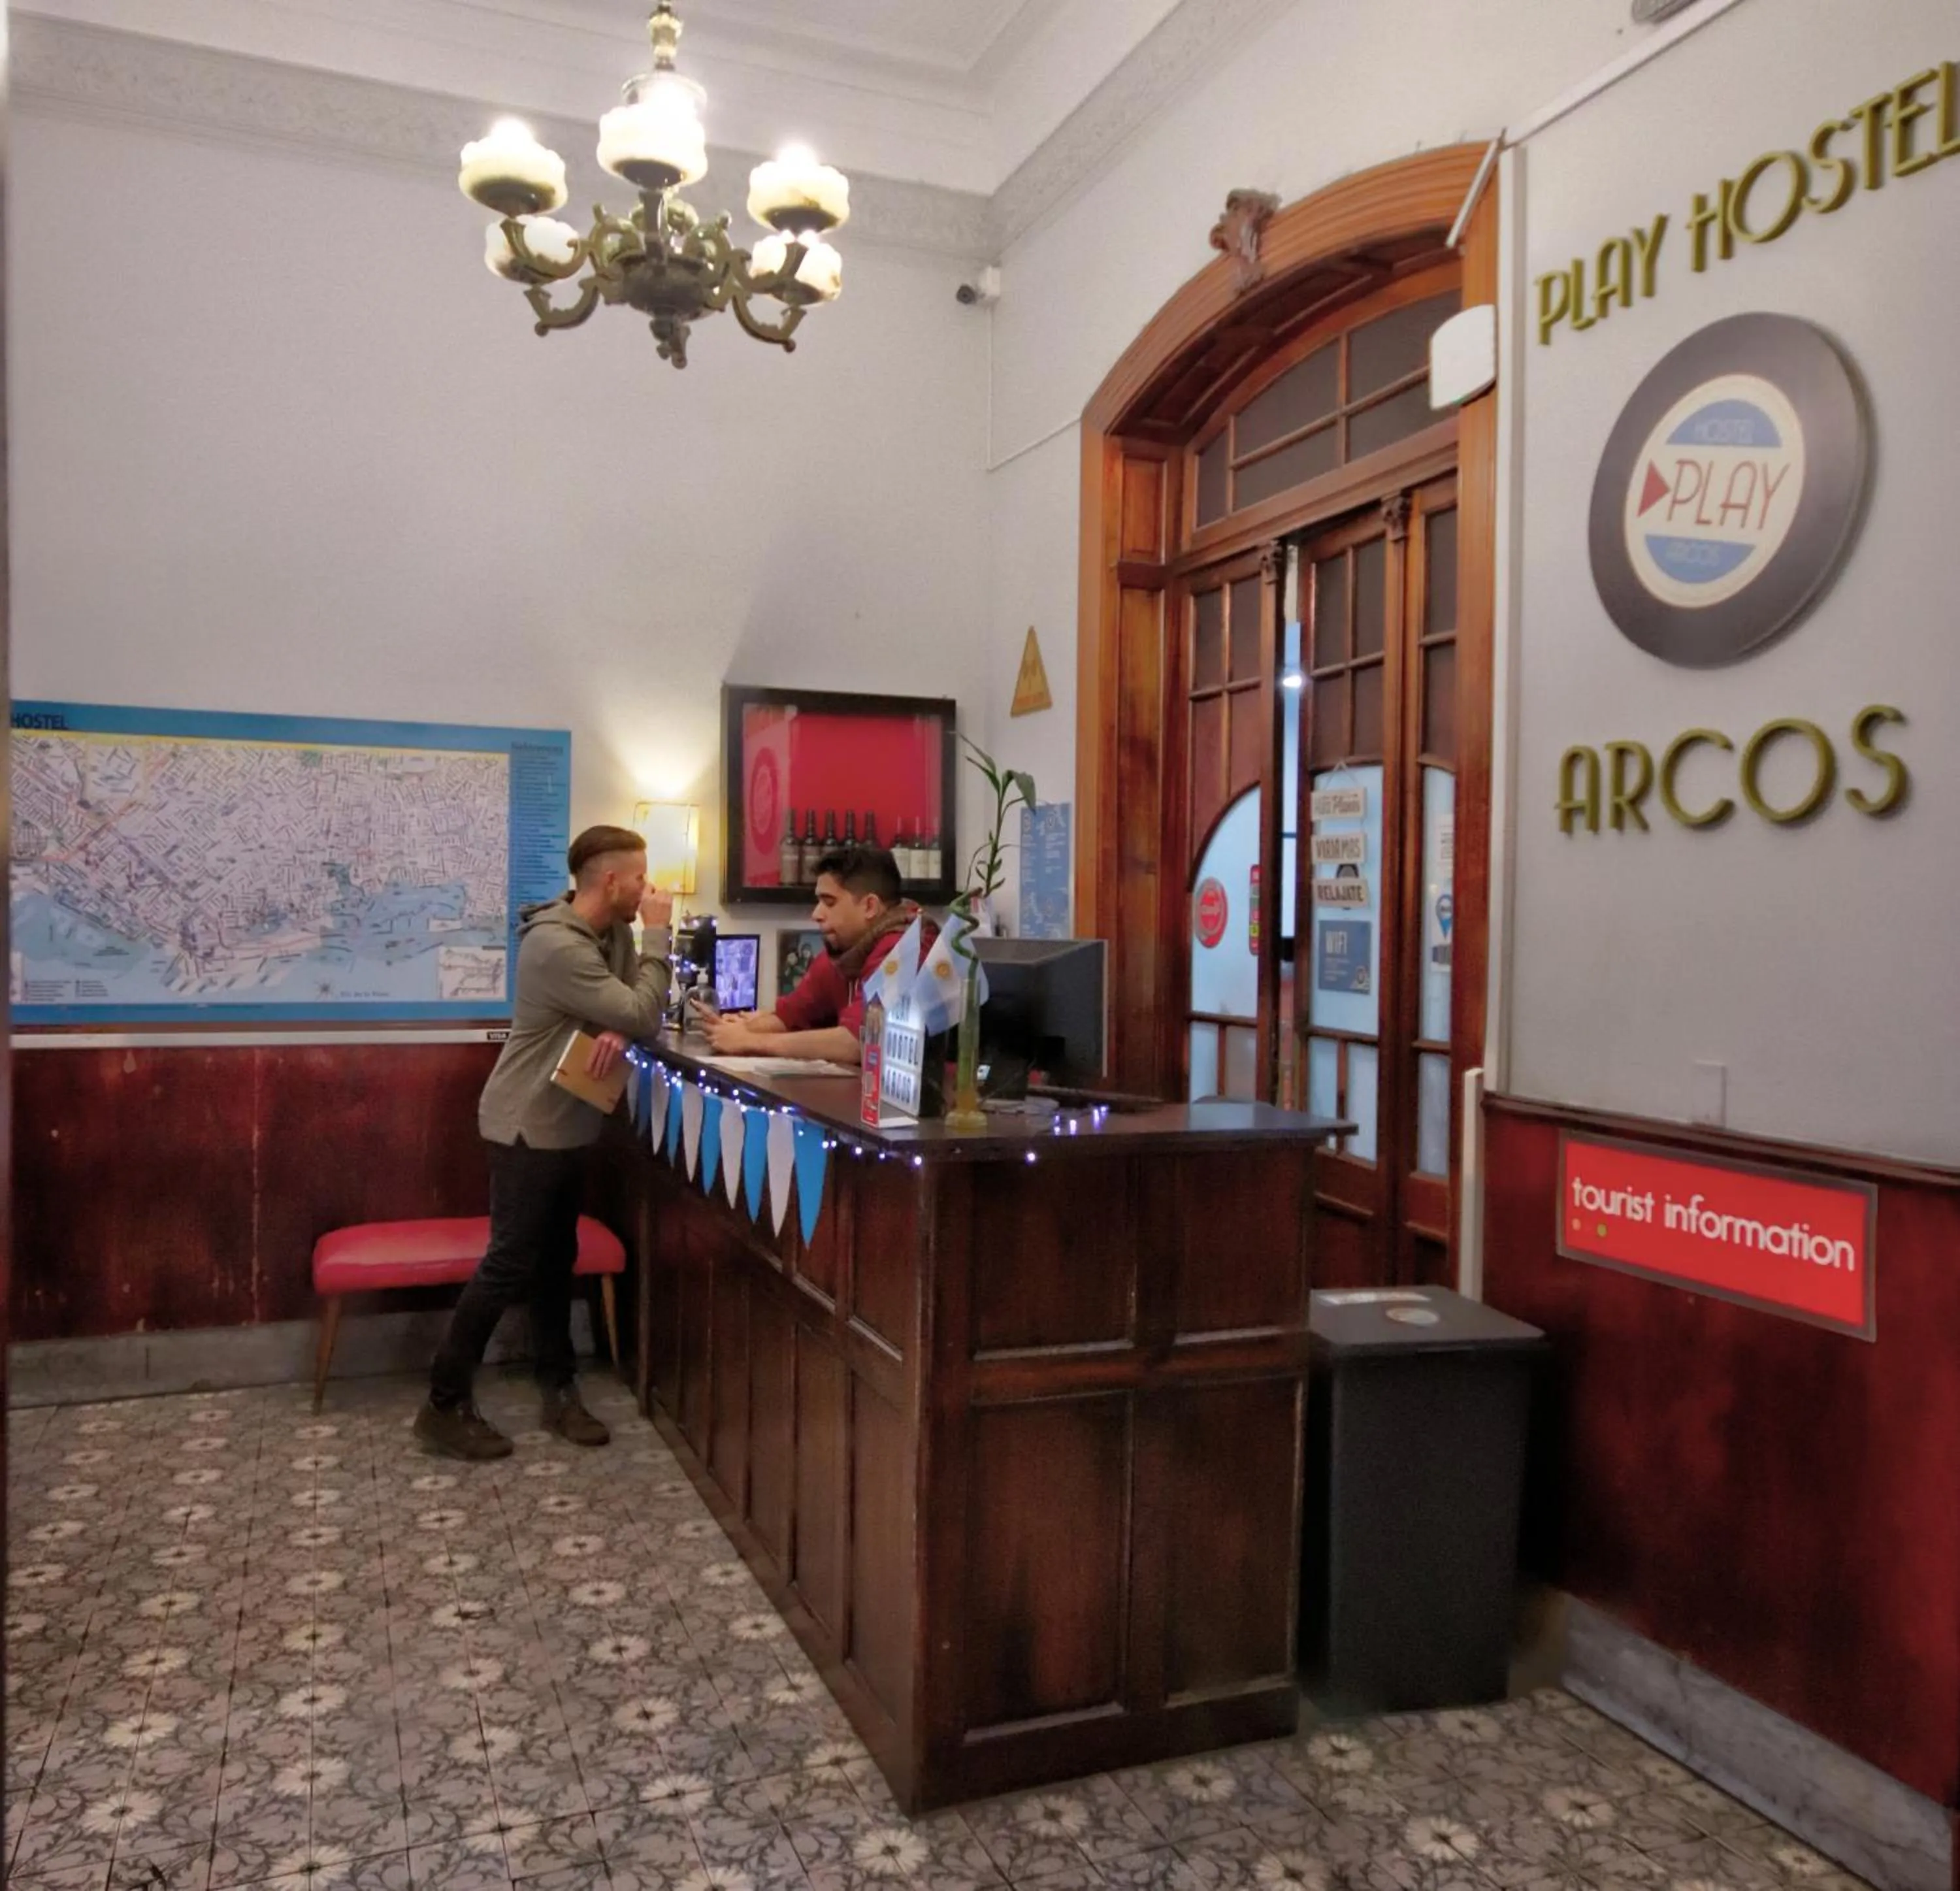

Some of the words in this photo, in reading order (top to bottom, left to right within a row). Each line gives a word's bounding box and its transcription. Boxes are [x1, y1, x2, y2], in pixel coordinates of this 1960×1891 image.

[1534, 214, 1669, 346] PLAY
[1686, 61, 1960, 272] HOSTEL
[1667, 459, 1791, 531] PLAY
[10, 712, 69, 731] HOSTEL
[1555, 704, 1909, 834] ARCOS
[1326, 930, 1348, 954] WIFI
[1572, 1177, 1655, 1223] tourist
[1664, 1194, 1855, 1272] information
